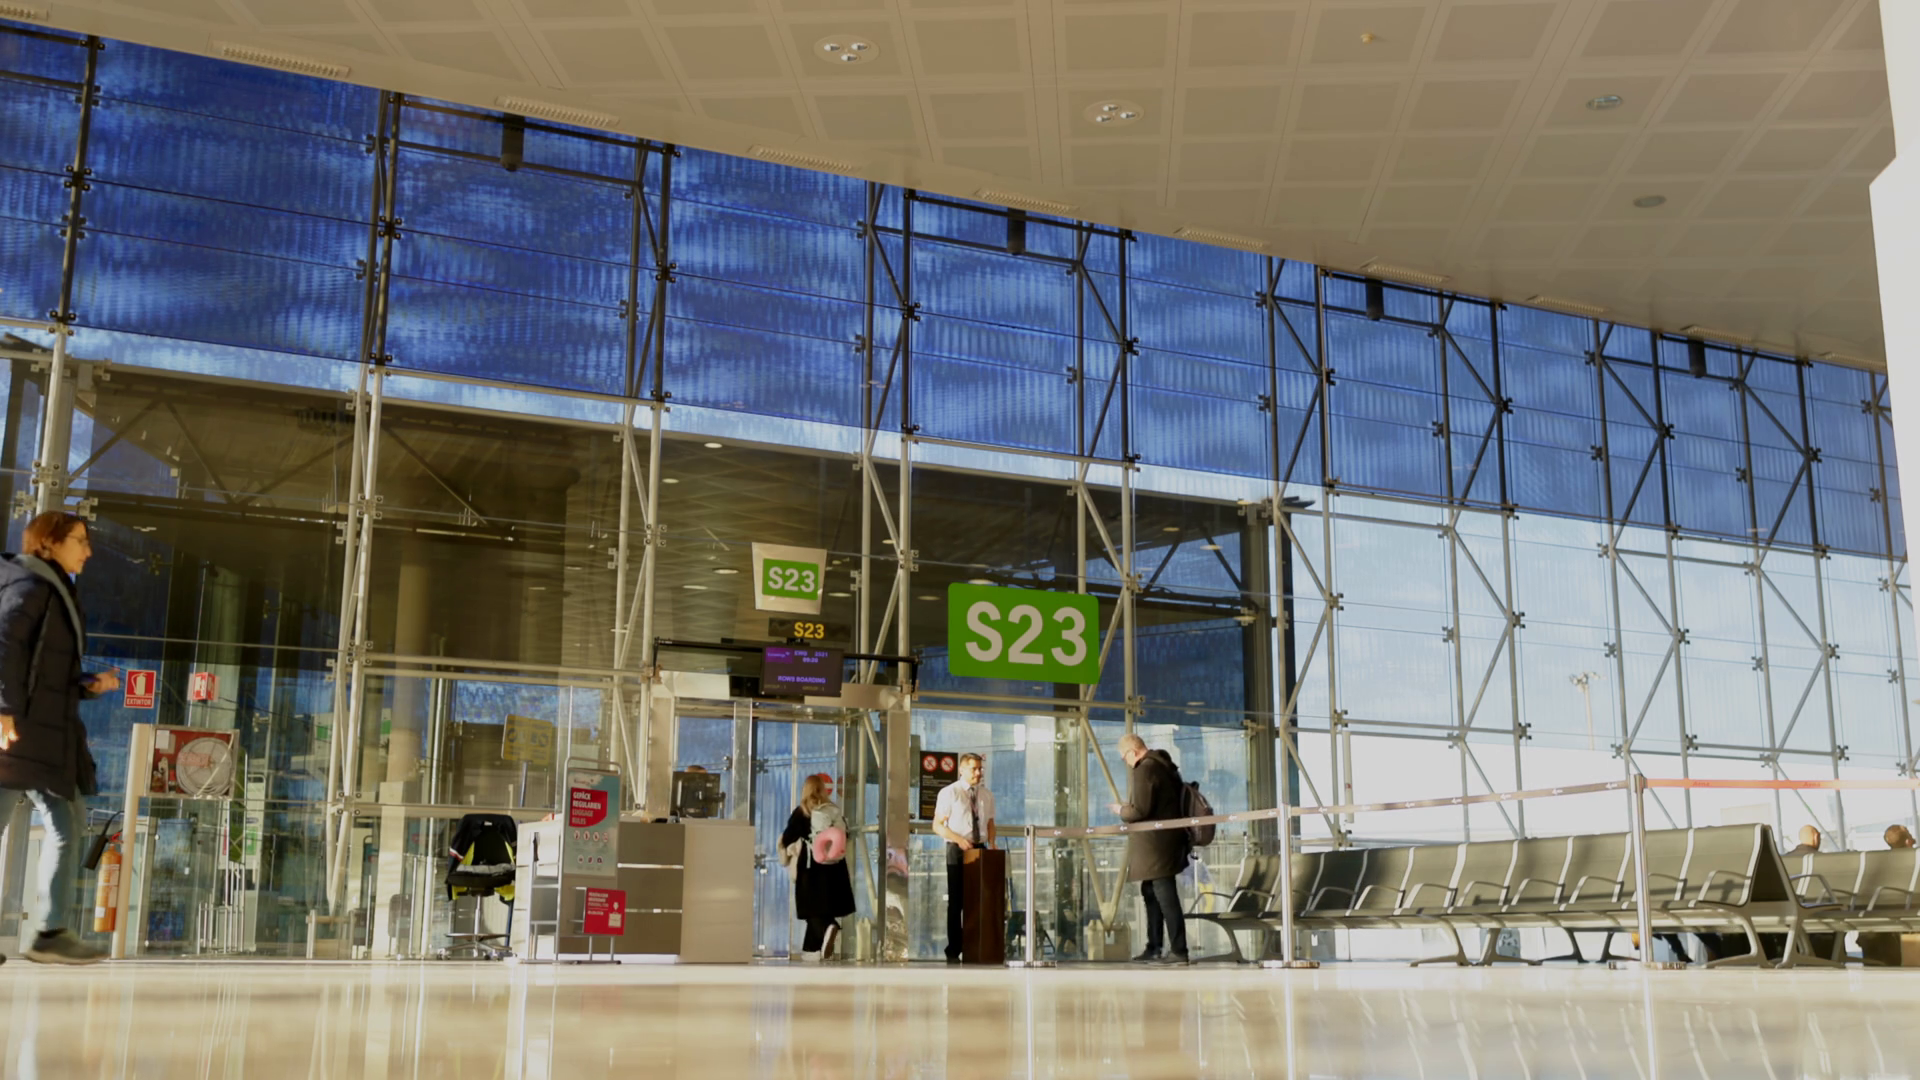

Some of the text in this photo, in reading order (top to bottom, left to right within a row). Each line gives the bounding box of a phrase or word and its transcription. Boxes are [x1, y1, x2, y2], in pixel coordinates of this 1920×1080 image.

[768, 566, 815, 593] S23
[794, 622, 824, 639] S23
[965, 601, 1087, 666] S23
[796, 676, 826, 684] BOARDING
[573, 791, 591, 800] GEPÄCK
